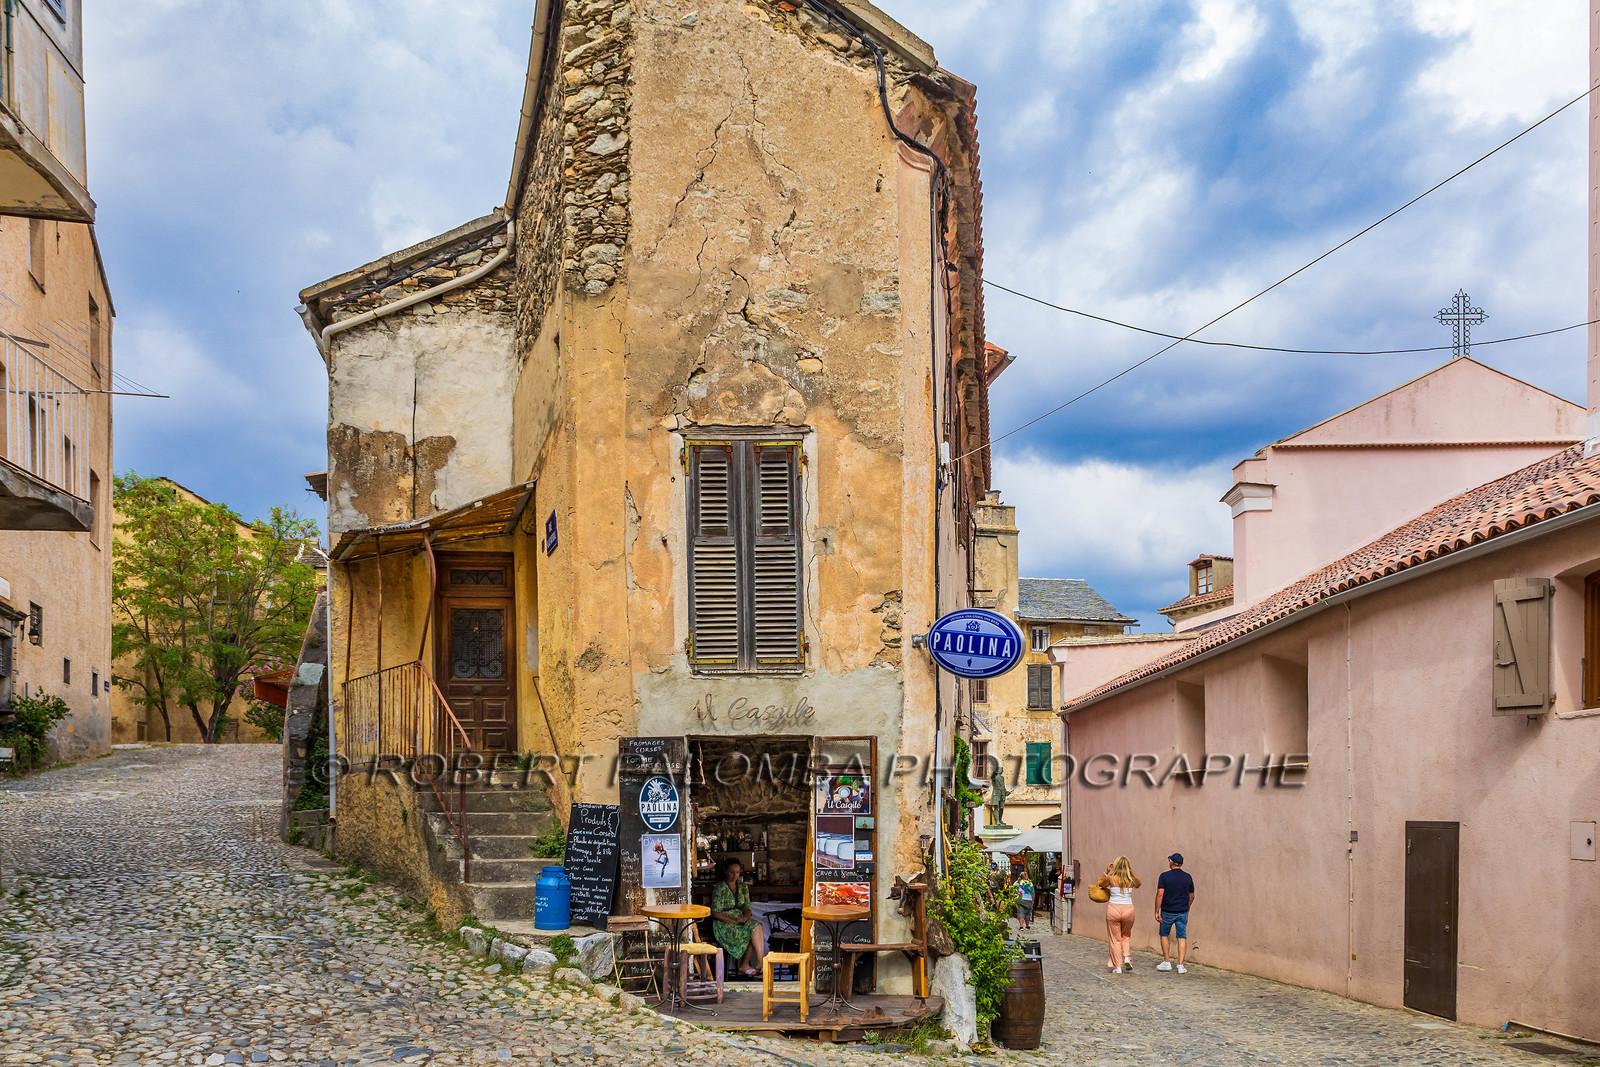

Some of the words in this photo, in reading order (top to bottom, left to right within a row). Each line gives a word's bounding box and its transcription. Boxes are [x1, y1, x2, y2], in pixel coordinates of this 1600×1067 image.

[933, 631, 1012, 658] PAOLINA
[727, 696, 816, 730] Casgile
[641, 803, 678, 812] PAOLINA
[835, 800, 862, 813] Casgile
[580, 808, 607, 826] Produits
[644, 838, 678, 848] DANSE
